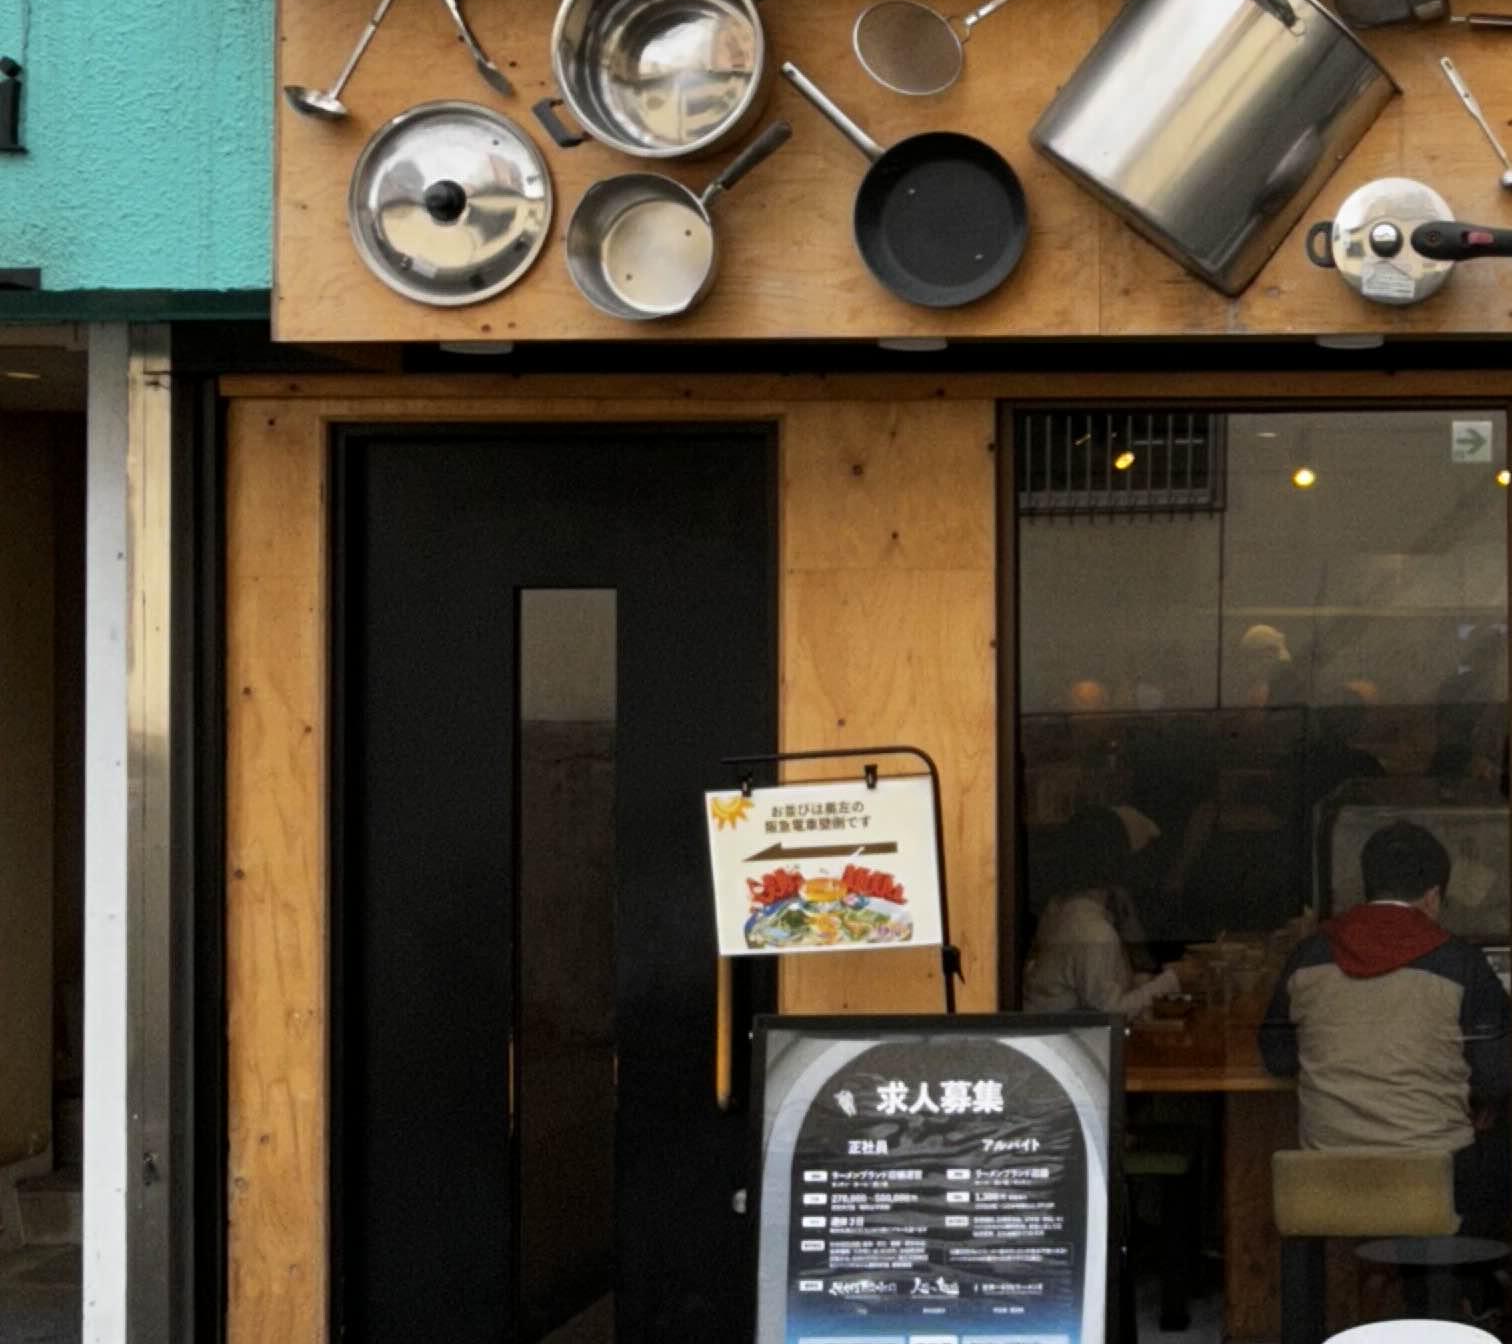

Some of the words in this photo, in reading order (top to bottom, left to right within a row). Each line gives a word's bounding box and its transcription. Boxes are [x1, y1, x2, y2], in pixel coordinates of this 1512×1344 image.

[876, 1080, 1004, 1115] 求人募集
[848, 1139, 888, 1155] 正社員
[981, 1138, 1041, 1153] アルバイト
